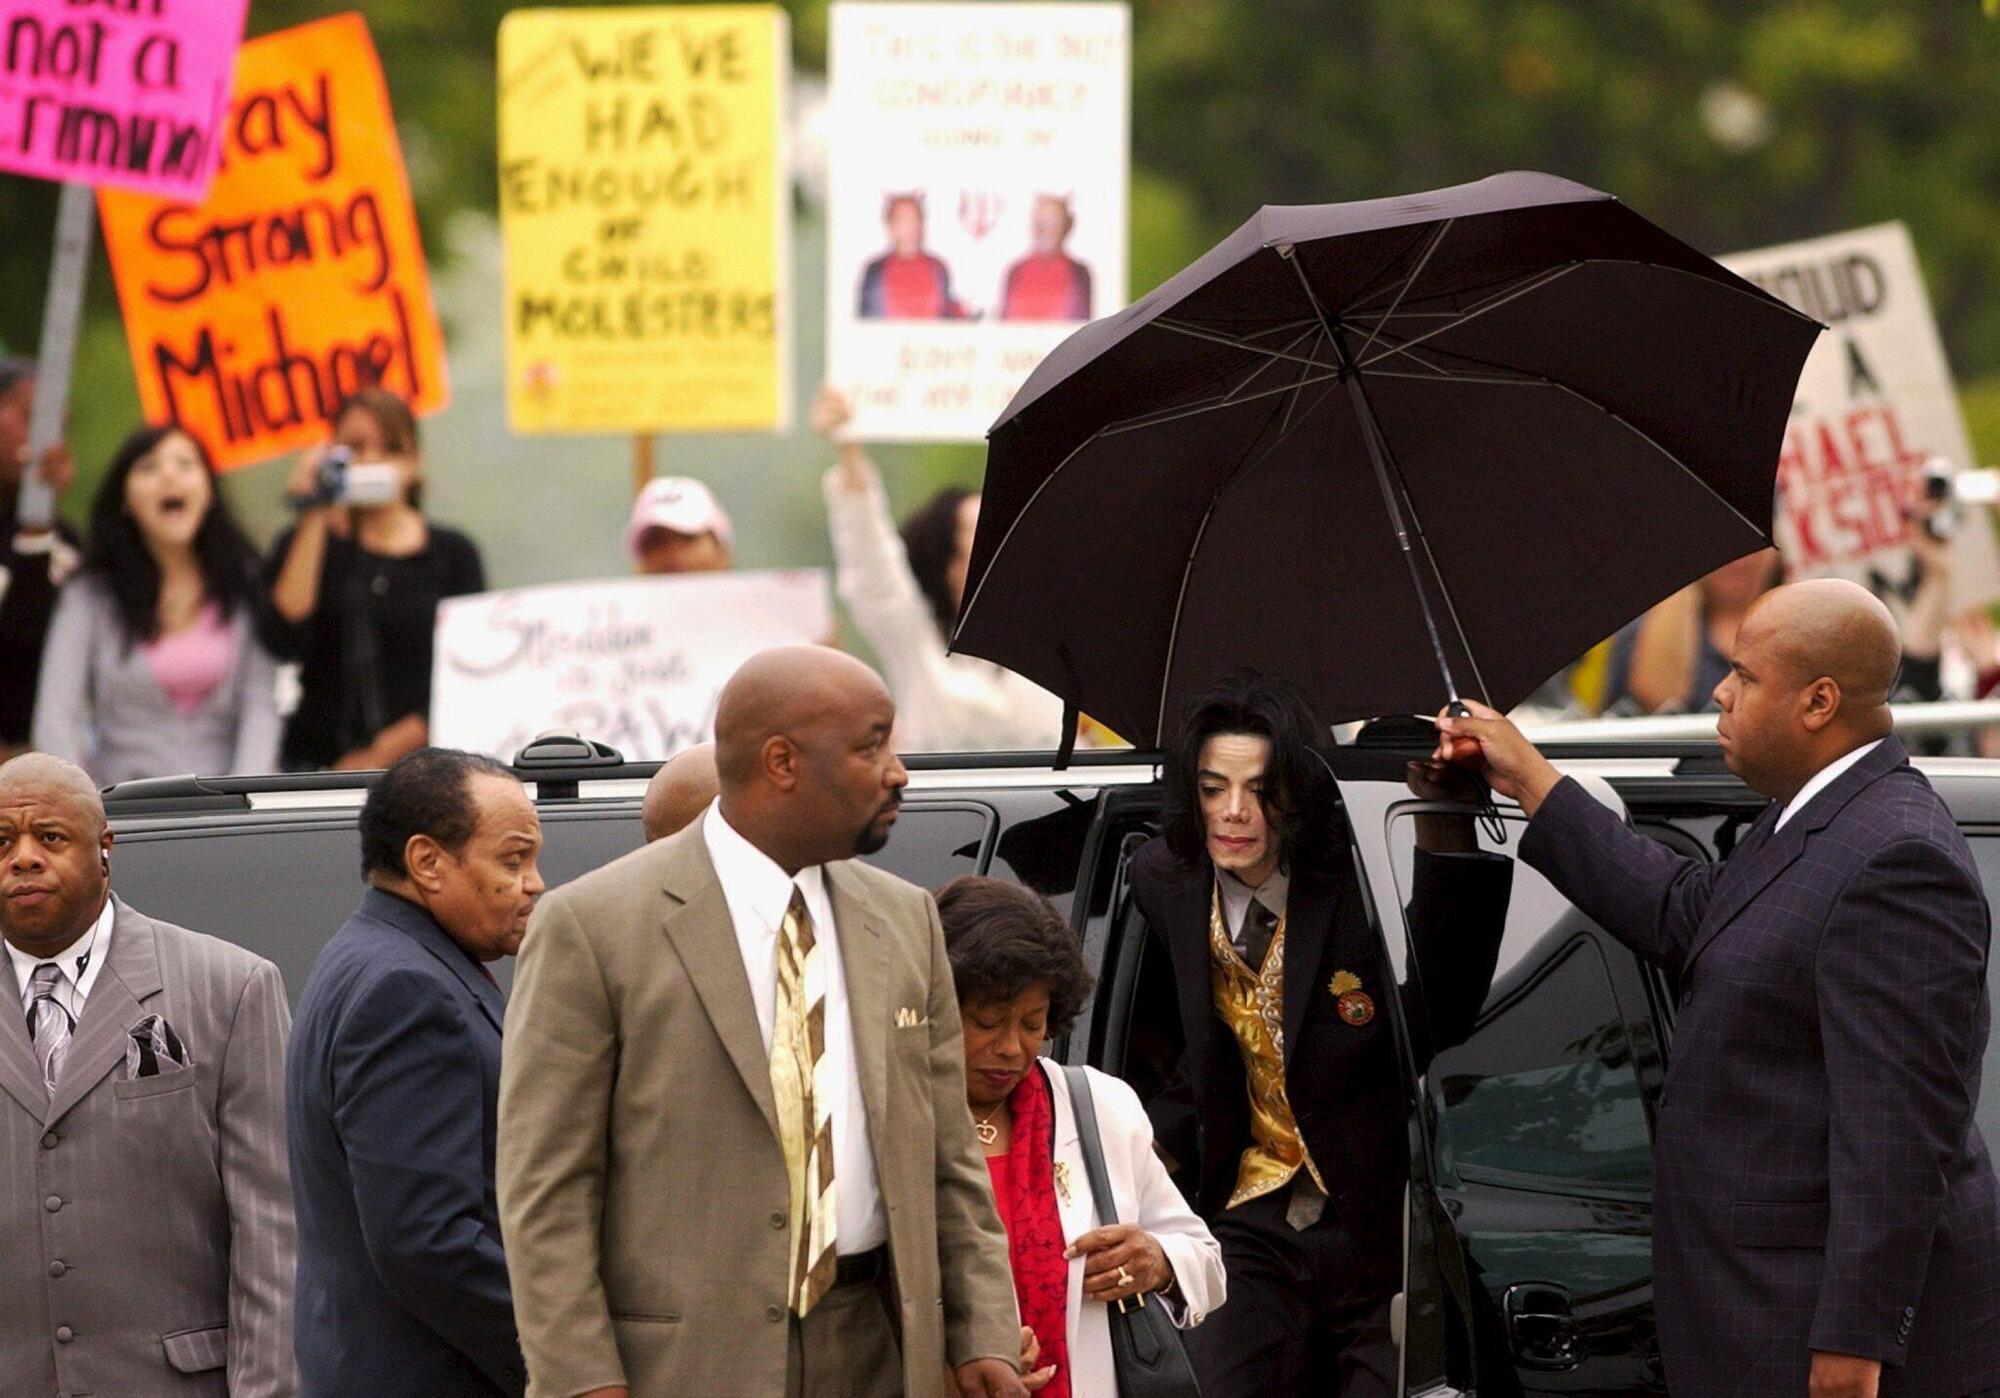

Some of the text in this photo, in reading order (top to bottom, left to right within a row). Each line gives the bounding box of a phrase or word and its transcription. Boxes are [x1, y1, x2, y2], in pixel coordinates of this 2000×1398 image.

[5, 15, 178, 90] not a
[217, 72, 334, 182] ay
[585, 93, 730, 153] HAD
[502, 156, 755, 214] ENOUGH
[561, 246, 710, 284] CHILD
[1752, 252, 1888, 323] OUD
[517, 291, 776, 341] MOLESTERS
[153, 290, 421, 446] Michael
[1779, 405, 1927, 494] HAEL
